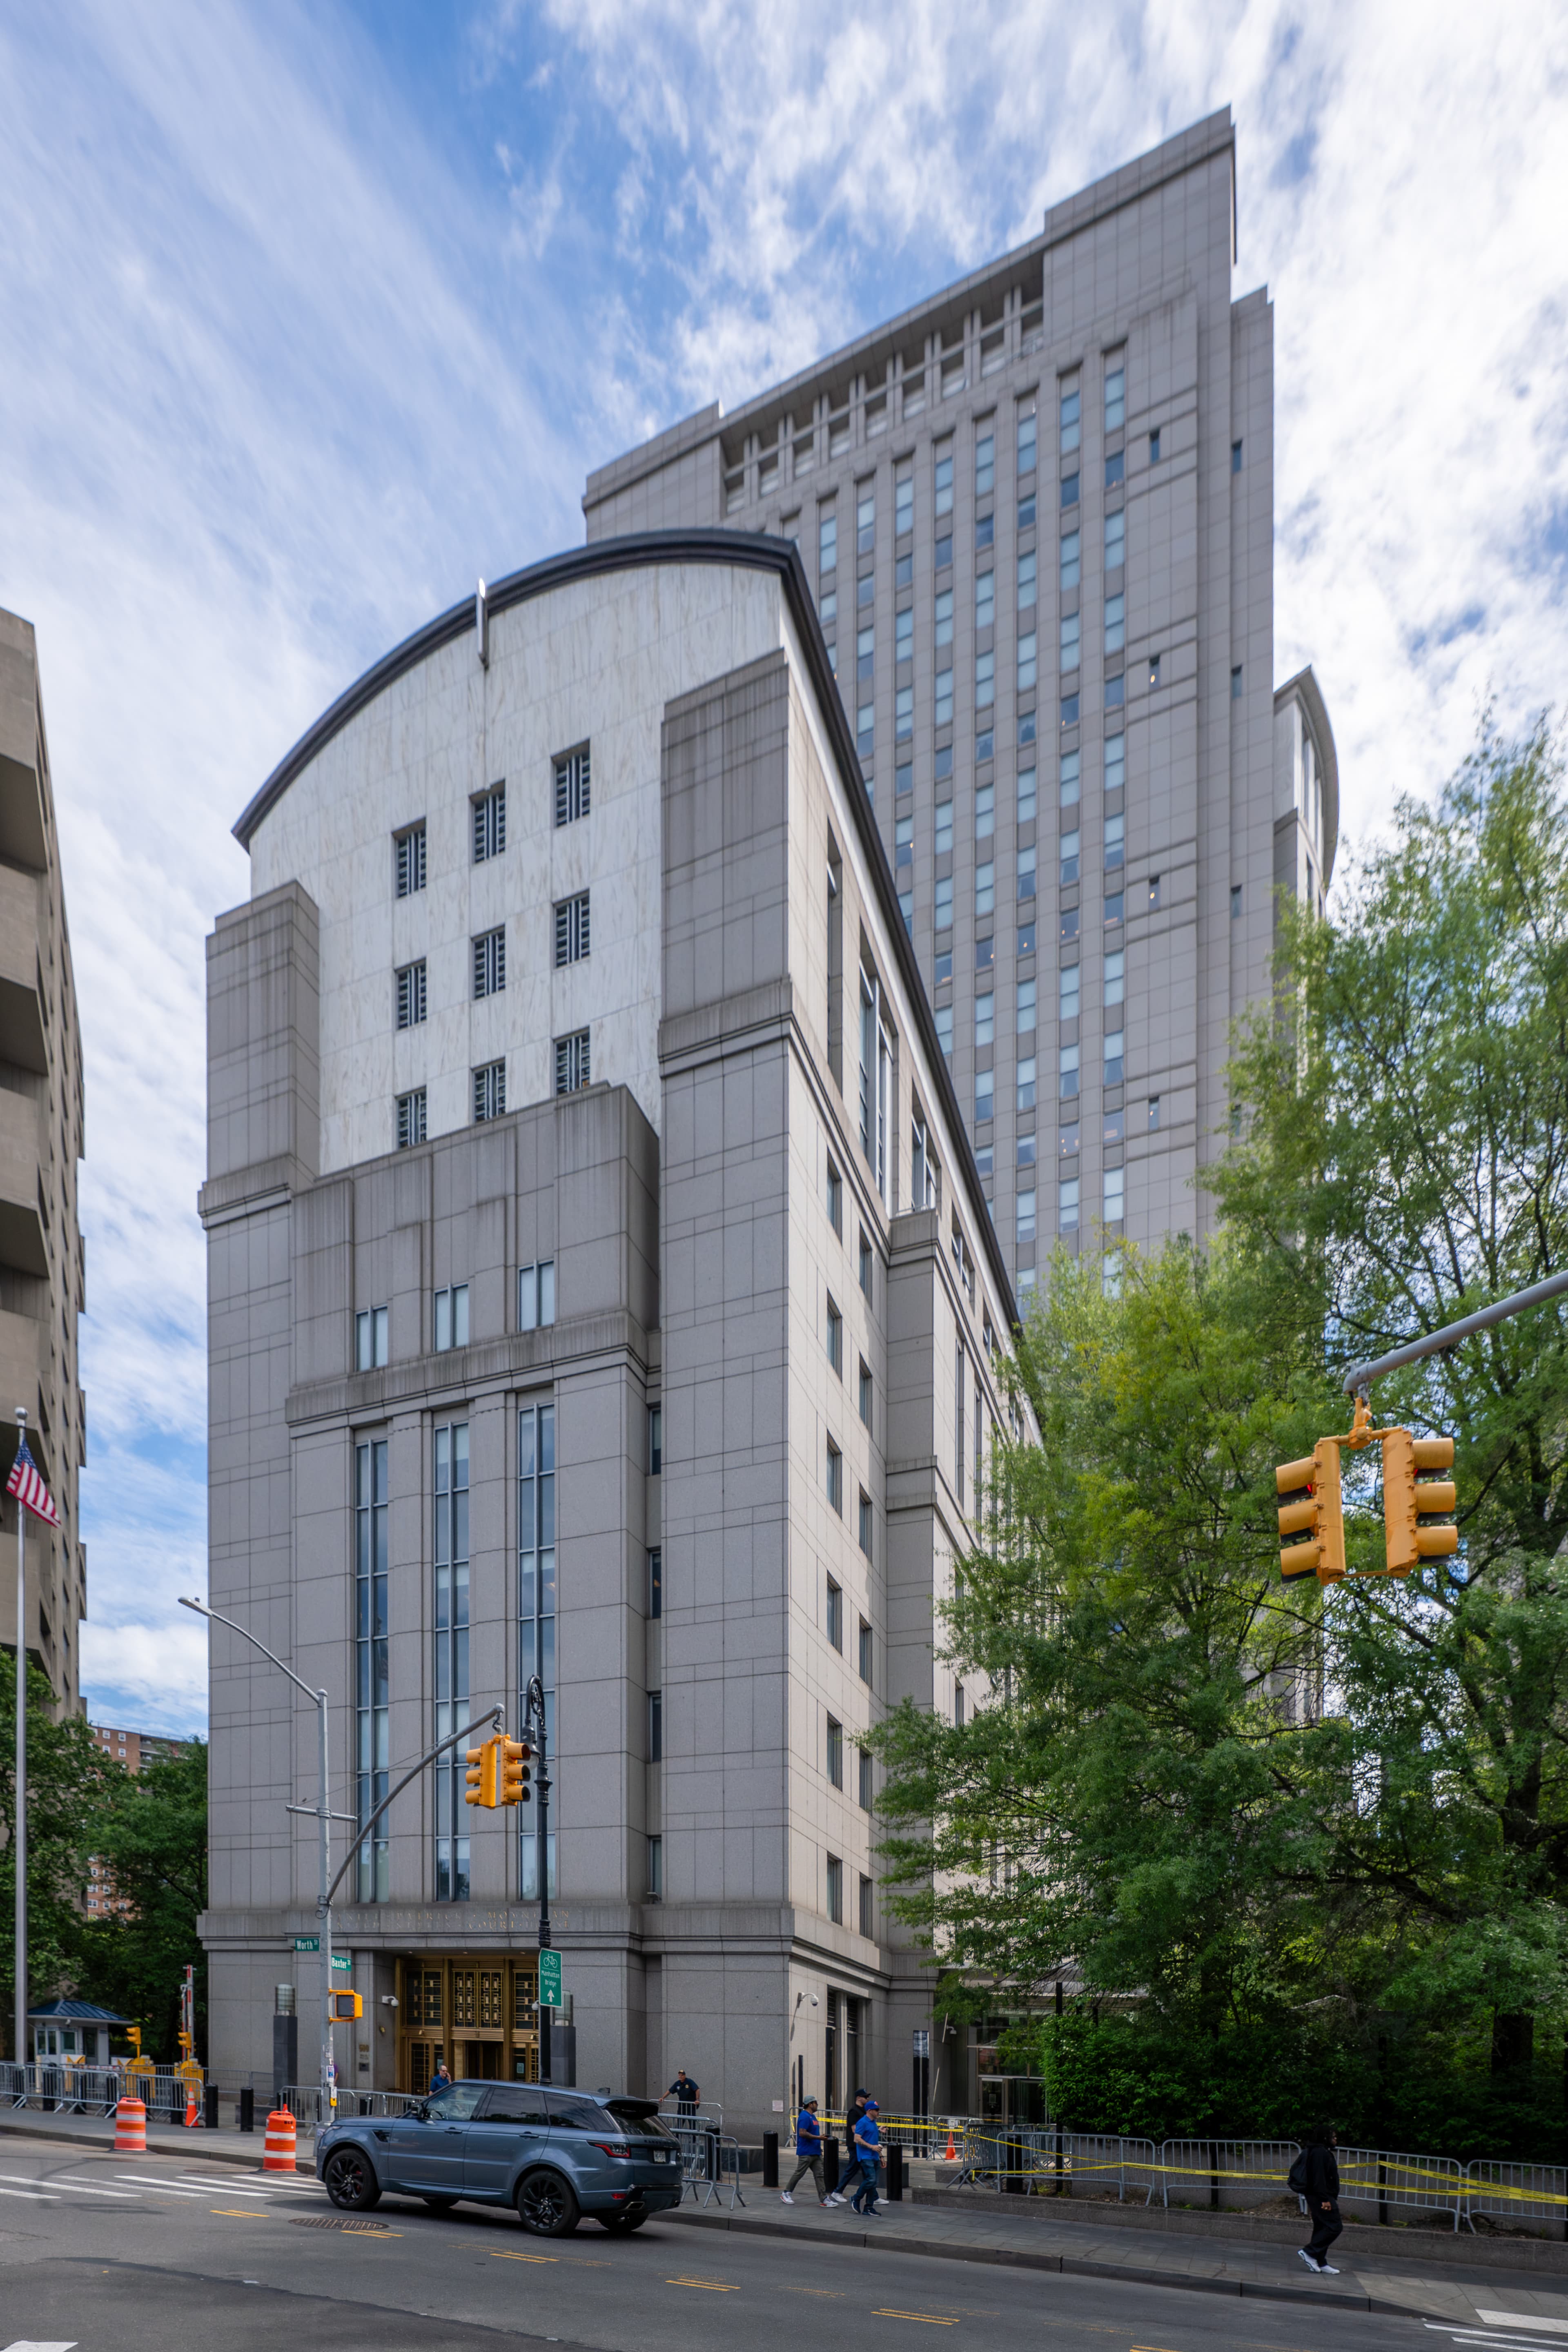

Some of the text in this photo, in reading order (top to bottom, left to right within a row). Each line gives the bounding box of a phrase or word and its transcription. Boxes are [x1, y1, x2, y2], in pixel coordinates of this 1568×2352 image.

[488, 1911, 569, 1919] MOYNIAN
[296, 1940, 313, 1950] Worth
[332, 1957, 347, 1969] Baxter
[541, 1970, 560, 1978] Manhattan
[545, 1979, 557, 1988] Bridge
